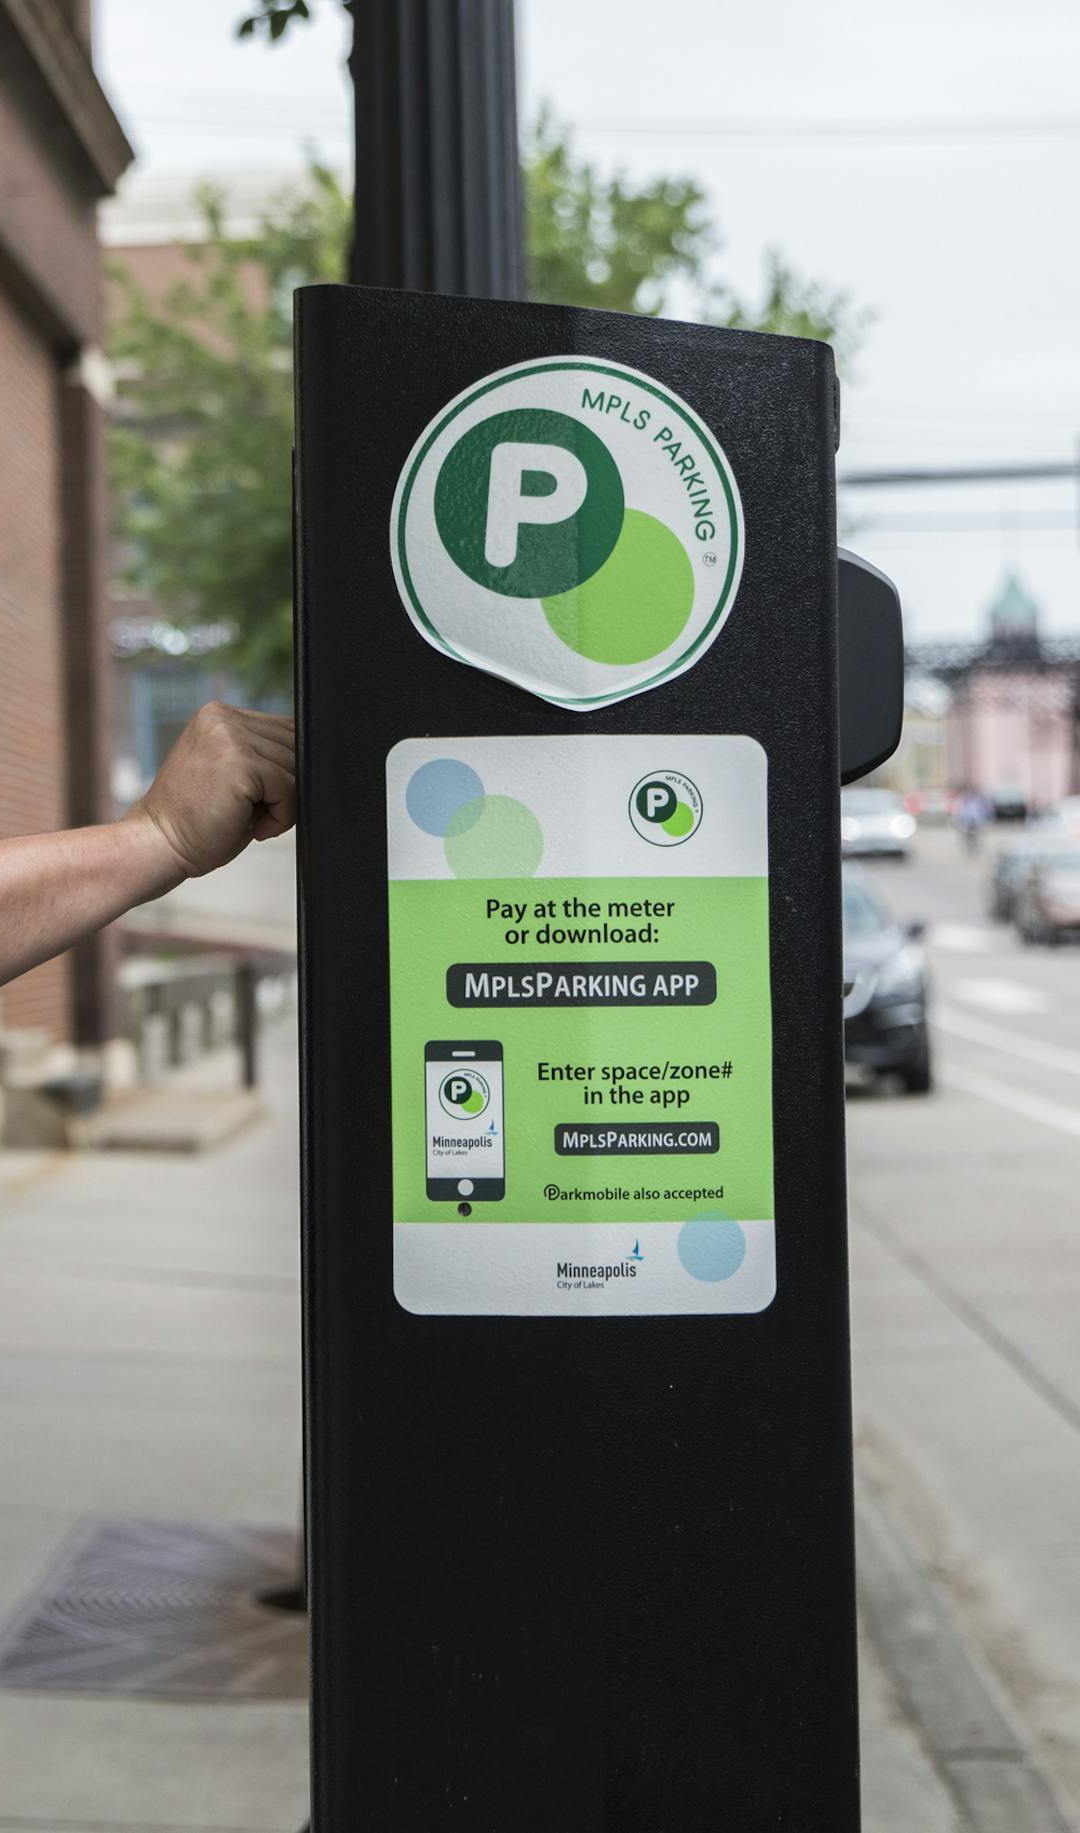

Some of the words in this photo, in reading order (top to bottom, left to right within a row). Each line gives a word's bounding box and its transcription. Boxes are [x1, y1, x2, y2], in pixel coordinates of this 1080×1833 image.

[581, 388, 651, 430] MPLS
[653, 426, 716, 541] PARKING
[484, 442, 588, 567] P
[647, 788, 669, 817] P
[486, 899, 527, 923] Pay
[534, 900, 557, 918] at
[562, 898, 601, 918] the
[608, 899, 675, 917] meter
[505, 929, 530, 944] or
[536, 923, 659, 943] download:
[652, 974, 700, 997] APP
[538, 1062, 596, 1081] Enter
[601, 1061, 733, 1084] space/zone#
[451, 1080, 467, 1101] P
[584, 1086, 603, 1104] in
[609, 1086, 644, 1104] the
[650, 1089, 690, 1108] app
[432, 1136, 492, 1149] Minneapolis
[544, 1184, 629, 1200] Parkmobile
[633, 1187, 660, 1200] also
[663, 1186, 724, 1201] accepted
[557, 1262, 637, 1281] Minneapolis
[557, 1281, 571, 1290] City
[573, 1280, 582, 1288] of
[583, 1281, 604, 1289] Lakes
